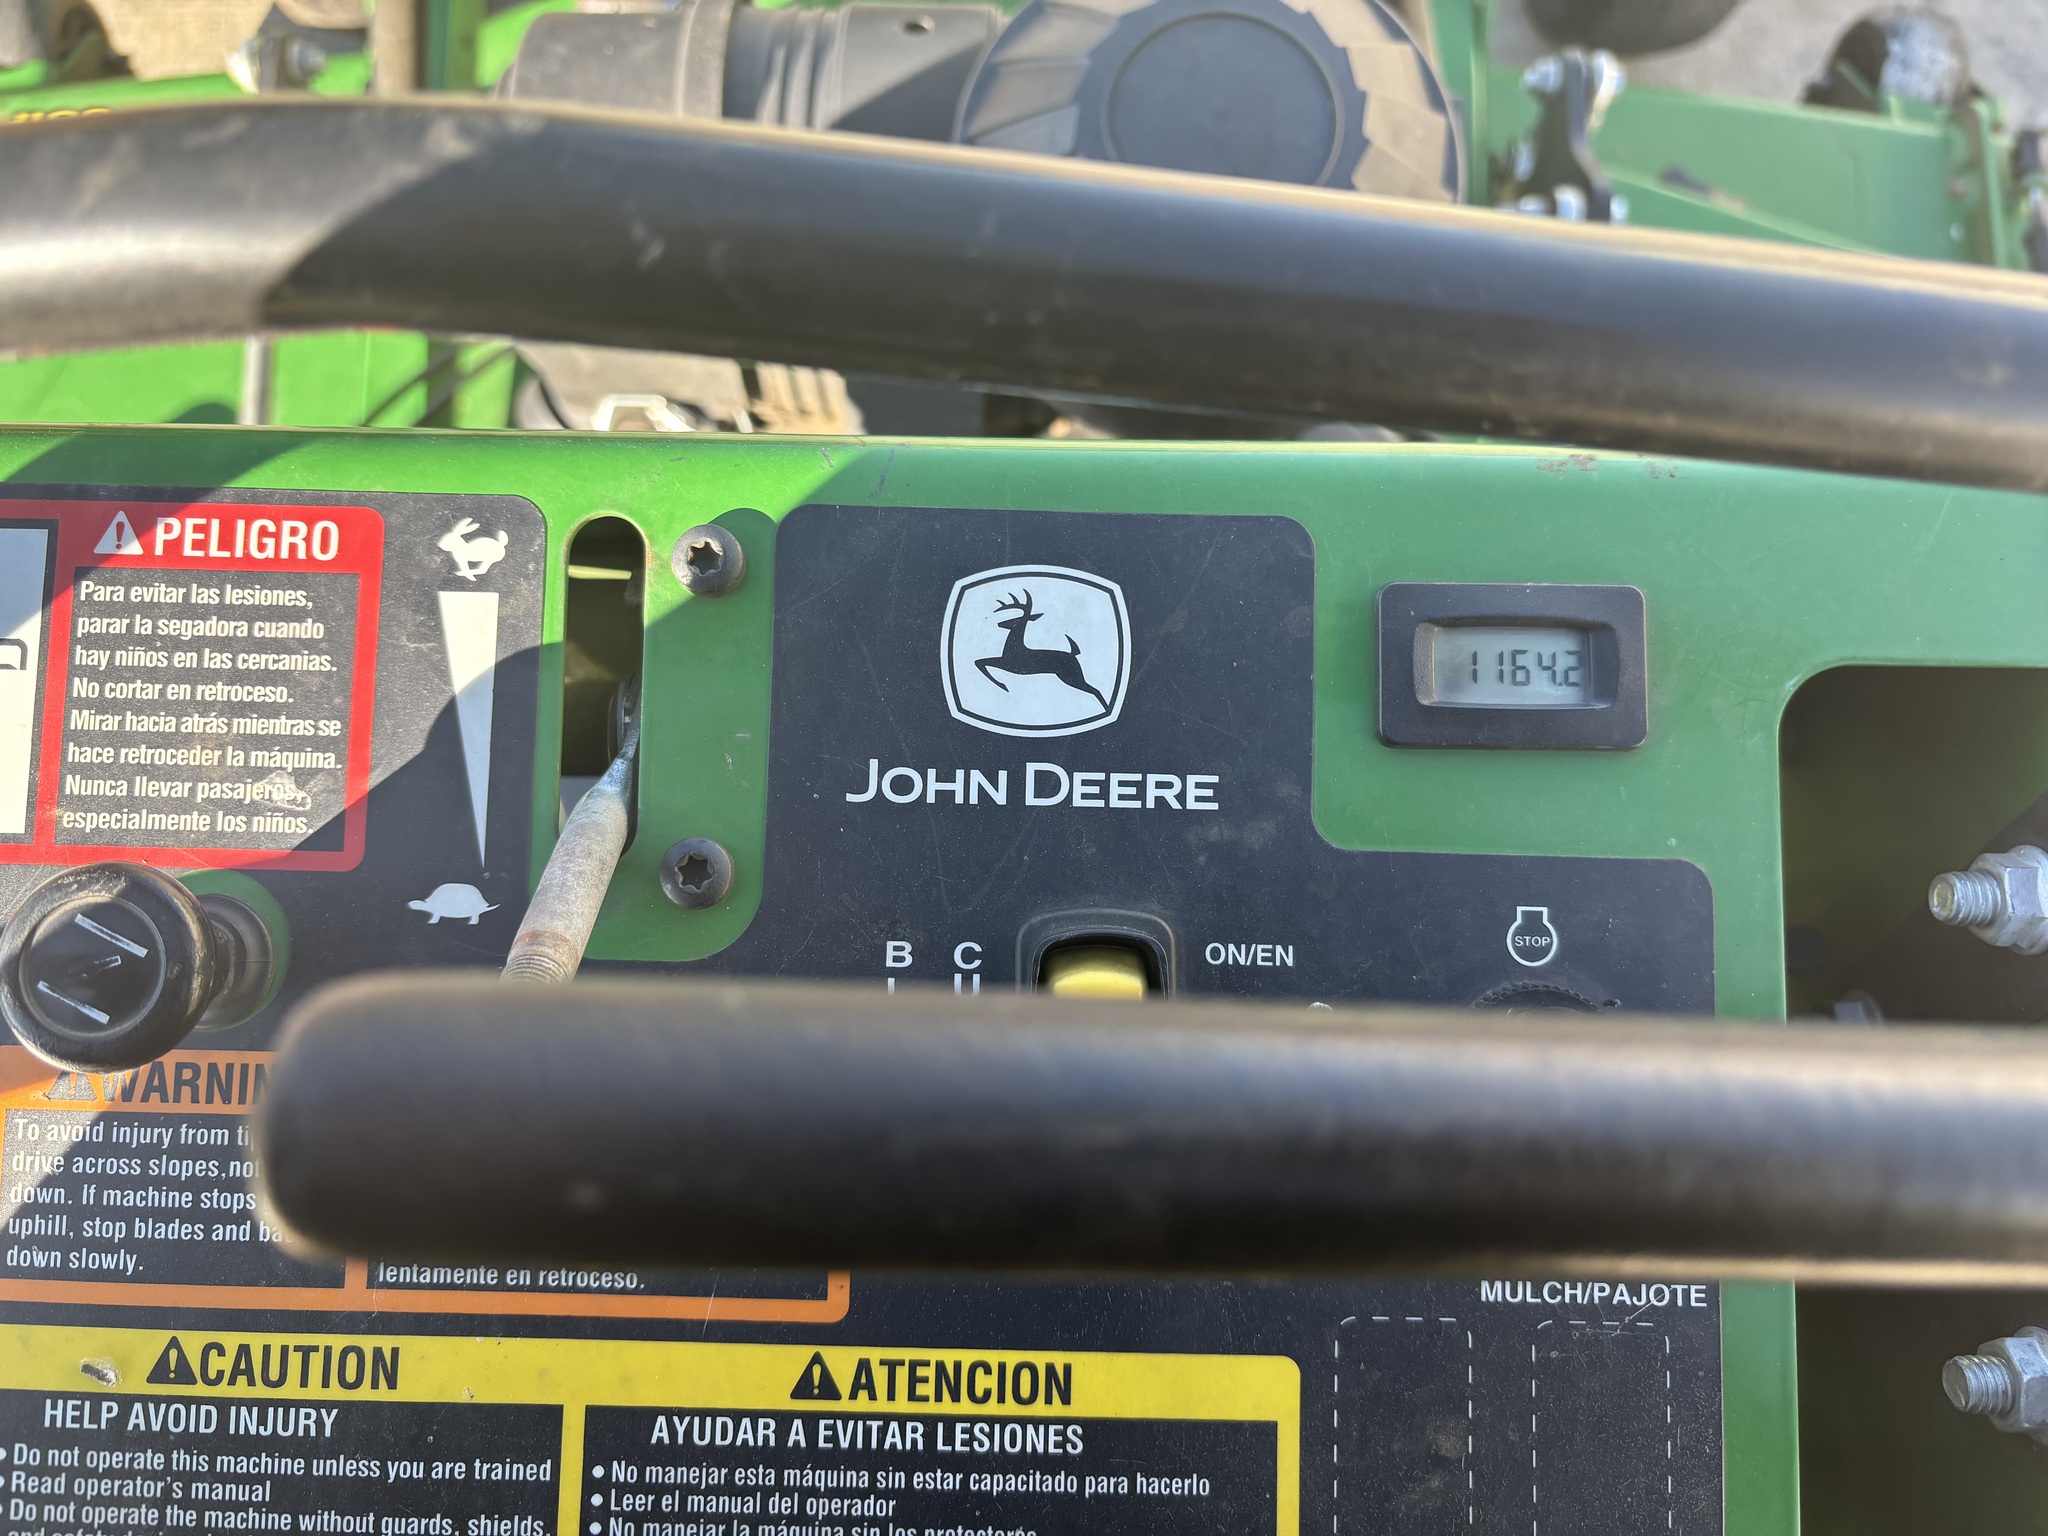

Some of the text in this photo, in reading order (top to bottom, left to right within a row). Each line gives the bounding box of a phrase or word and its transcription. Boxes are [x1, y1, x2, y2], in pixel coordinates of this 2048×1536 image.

[154, 516, 340, 562] PELIGRO
[79, 580, 314, 610] Para evitar las lesiones,
[76, 614, 325, 641] parar la segadora cuando
[74, 645, 111, 672] hay
[115, 646, 169, 669] niños
[173, 650, 198, 669] en
[203, 648, 233, 670] las
[1471, 649, 1582, 687] 1164.2
[72, 677, 295, 704] No cortar en retroceso.
[69, 709, 342, 737] Mirar hacia atrás mientras se
[67, 742, 343, 773] hace retroceder la máquina.
[64, 774, 129, 797] Nunca
[134, 776, 193, 798] llevar
[845, 757, 1220, 812] JOHN DEERE
[62, 809, 314, 834] especialmente los niños.
[1204, 941, 1294, 968] ON/EN
[1514, 935, 1551, 948] STOP
[14, 1118, 40, 1141] To
[46, 1121, 105, 1143] avoid
[111, 1121, 174, 1149] injury
[179, 1123, 230, 1146] from
[11, 1151, 65, 1174] drive
[71, 1156, 142, 1176] across
[9, 1182, 257, 1214] down. If machine stops
[7, 1213, 74, 1240] uphill,
[82, 1217, 127, 1243] stop
[133, 1217, 205, 1241] blades
[211, 1220, 252, 1242] and
[6, 1244, 144, 1276] down slowly.
[378, 1261, 646, 1290] lentamente en retroceso.
[1479, 1279, 1708, 1308] MULCH/PAJOTE
[199, 1342, 401, 1392] CAUTION
[848, 1357, 1074, 1407] ATENCION
[43, 1398, 340, 1438] HELP AVOID INJURY
[649, 1414, 1085, 1455] AYUDAR A EVITAR LESIONES
[13, 1442, 552, 1484] Do not operate this machine unless you are trained
[10, 1470, 66, 1495] Read
[190, 1479, 271, 1502] manual
[611, 1460, 1211, 1499] No manejar esta máquina sin estar capacitado para hacerlo
[8, 1498, 38, 1523] Do
[43, 1501, 76, 1524] not
[81, 1503, 160, 1529] operate
[164, 1504, 197, 1527] the
[203, 1507, 293, 1531] machine
[298, 1509, 376, 1534] without
[609, 1488, 897, 1519] Leer el manual del operador
[608, 1516, 635, 1536] No
